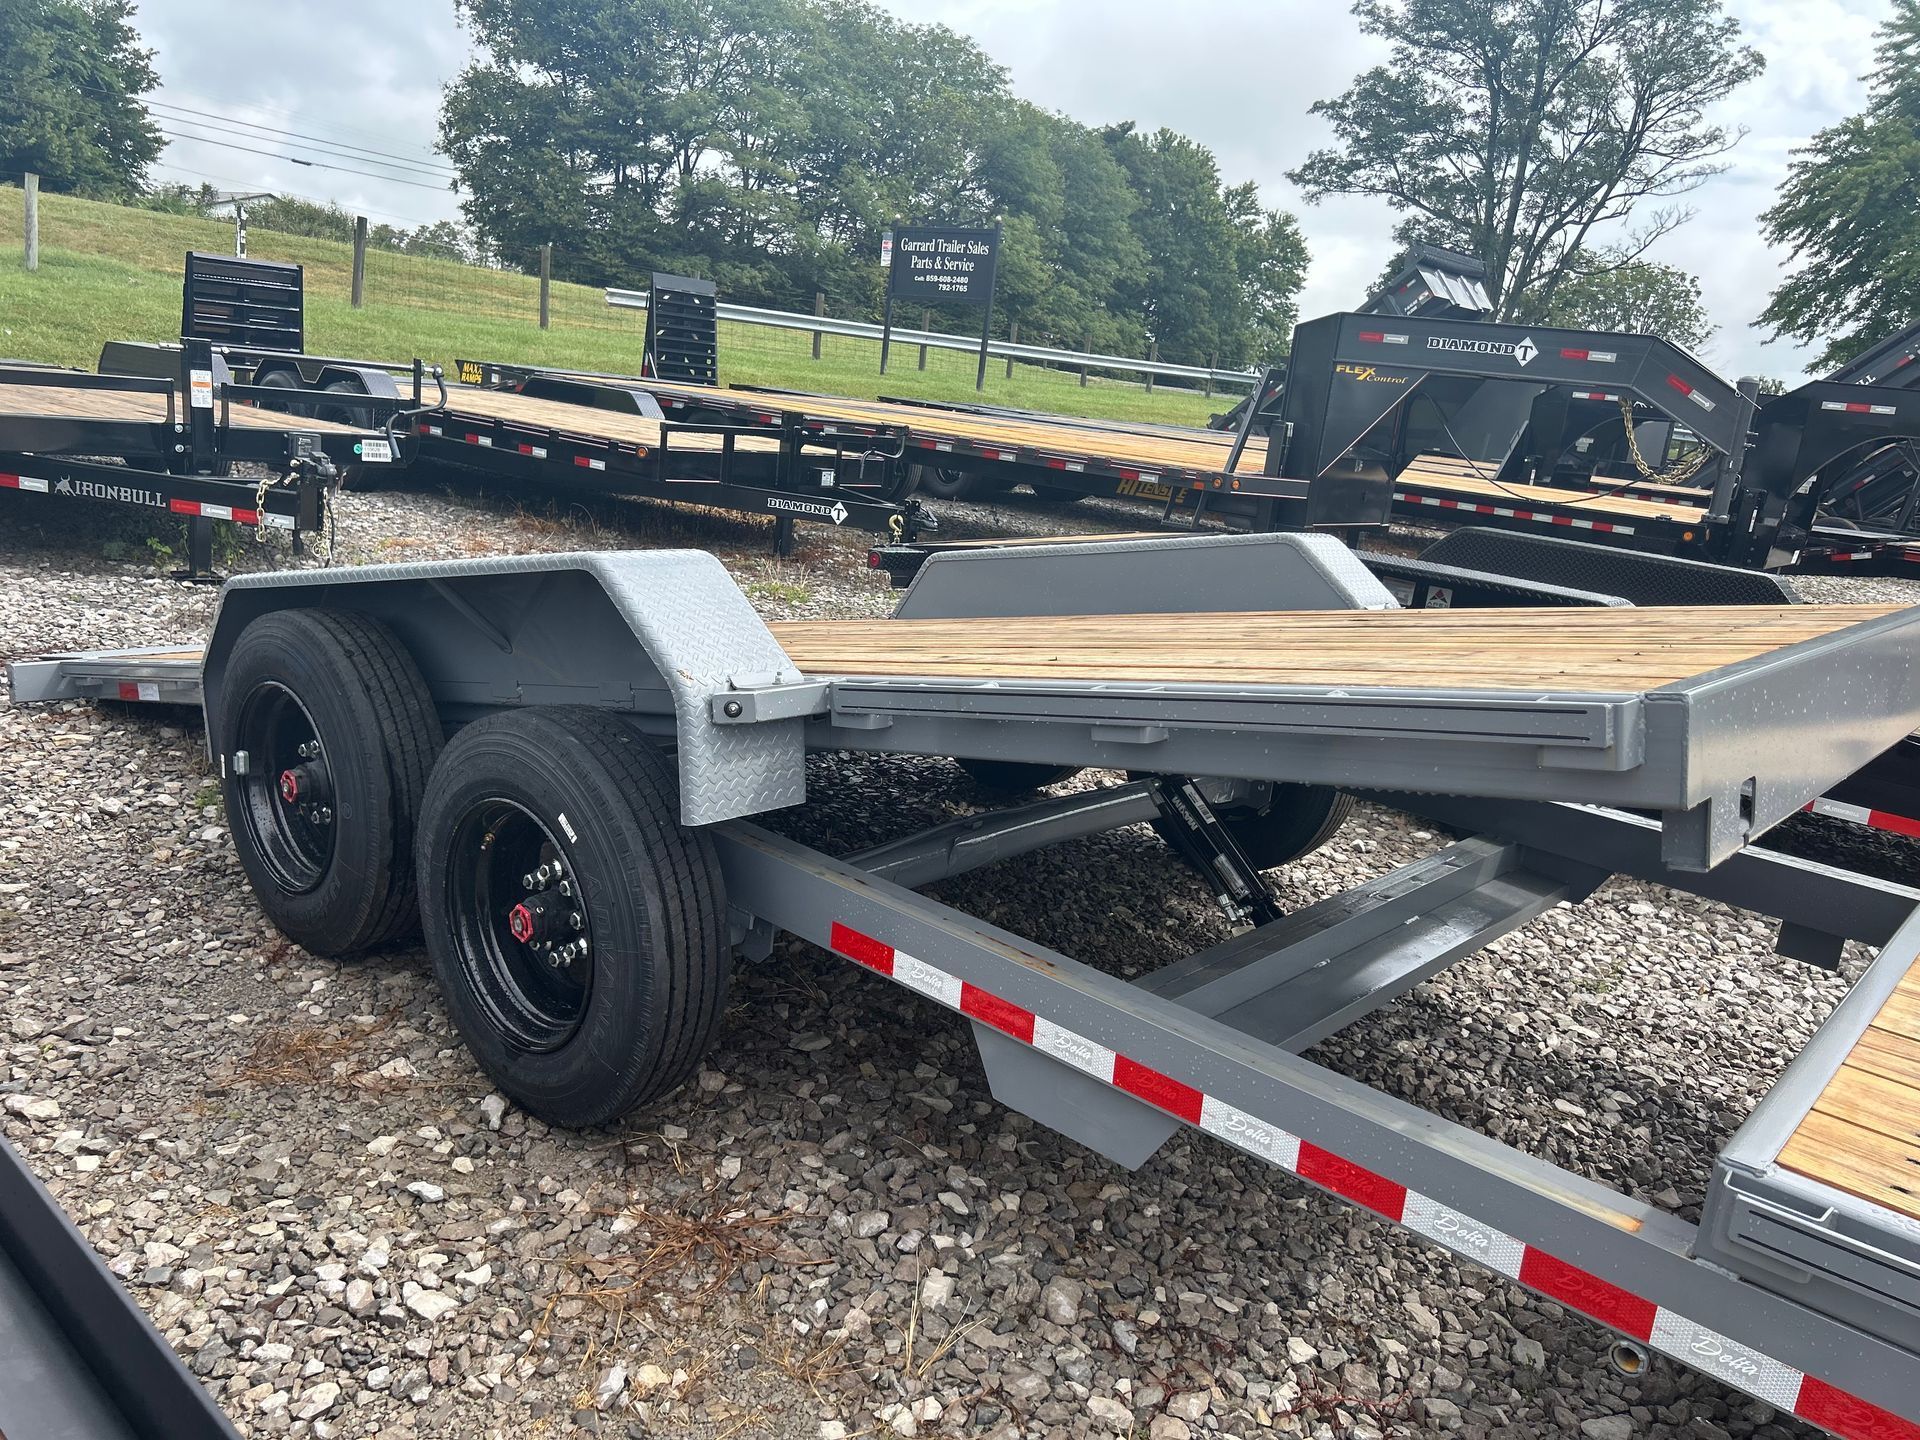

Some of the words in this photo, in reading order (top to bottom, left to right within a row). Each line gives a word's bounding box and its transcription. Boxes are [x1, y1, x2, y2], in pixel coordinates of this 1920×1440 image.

[901, 237, 935, 252] Garrard
[937, 239, 966, 253] Trailer
[967, 240, 990, 255] Sales
[911, 255, 932, 269] Parts
[934, 256, 942, 270] &
[944, 257, 974, 271] Service
[926, 274, 969, 283] 859-608-2480
[938, 284, 968, 292] 792-1765
[1427, 336, 1517, 356] DIAMOND
[461, 372, 482, 384] RAMPS
[1336, 364, 1377, 381] FLEX
[1366, 374, 1409, 384] Control
[75, 480, 167, 508] IRONBULL
[1138, 481, 1188, 499] TENSE
[767, 497, 832, 516] DIAMOND
[1224, 1114, 1272, 1145] Delta
[1433, 1212, 1490, 1249] Delta
[1690, 1335, 1760, 1376] Delta
